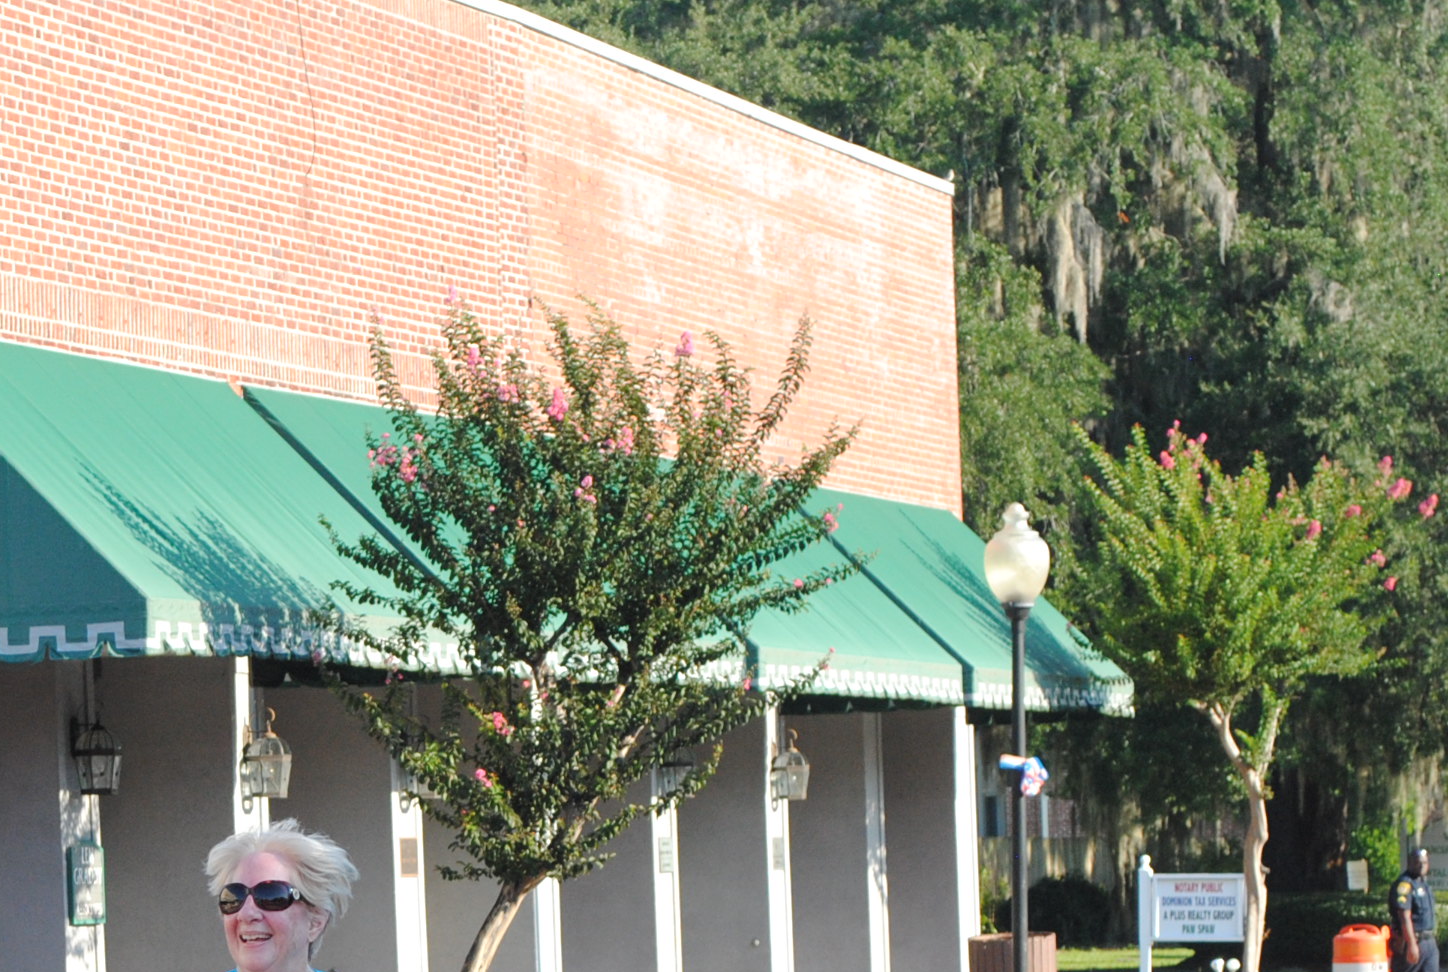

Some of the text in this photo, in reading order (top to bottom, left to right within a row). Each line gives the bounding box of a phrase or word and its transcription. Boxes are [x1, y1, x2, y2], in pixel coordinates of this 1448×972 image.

[1174, 883, 1223, 893] NOTARY PUBLIC
[1208, 896, 1236, 906] SERVICES
[1187, 910, 1212, 920] REALTY
